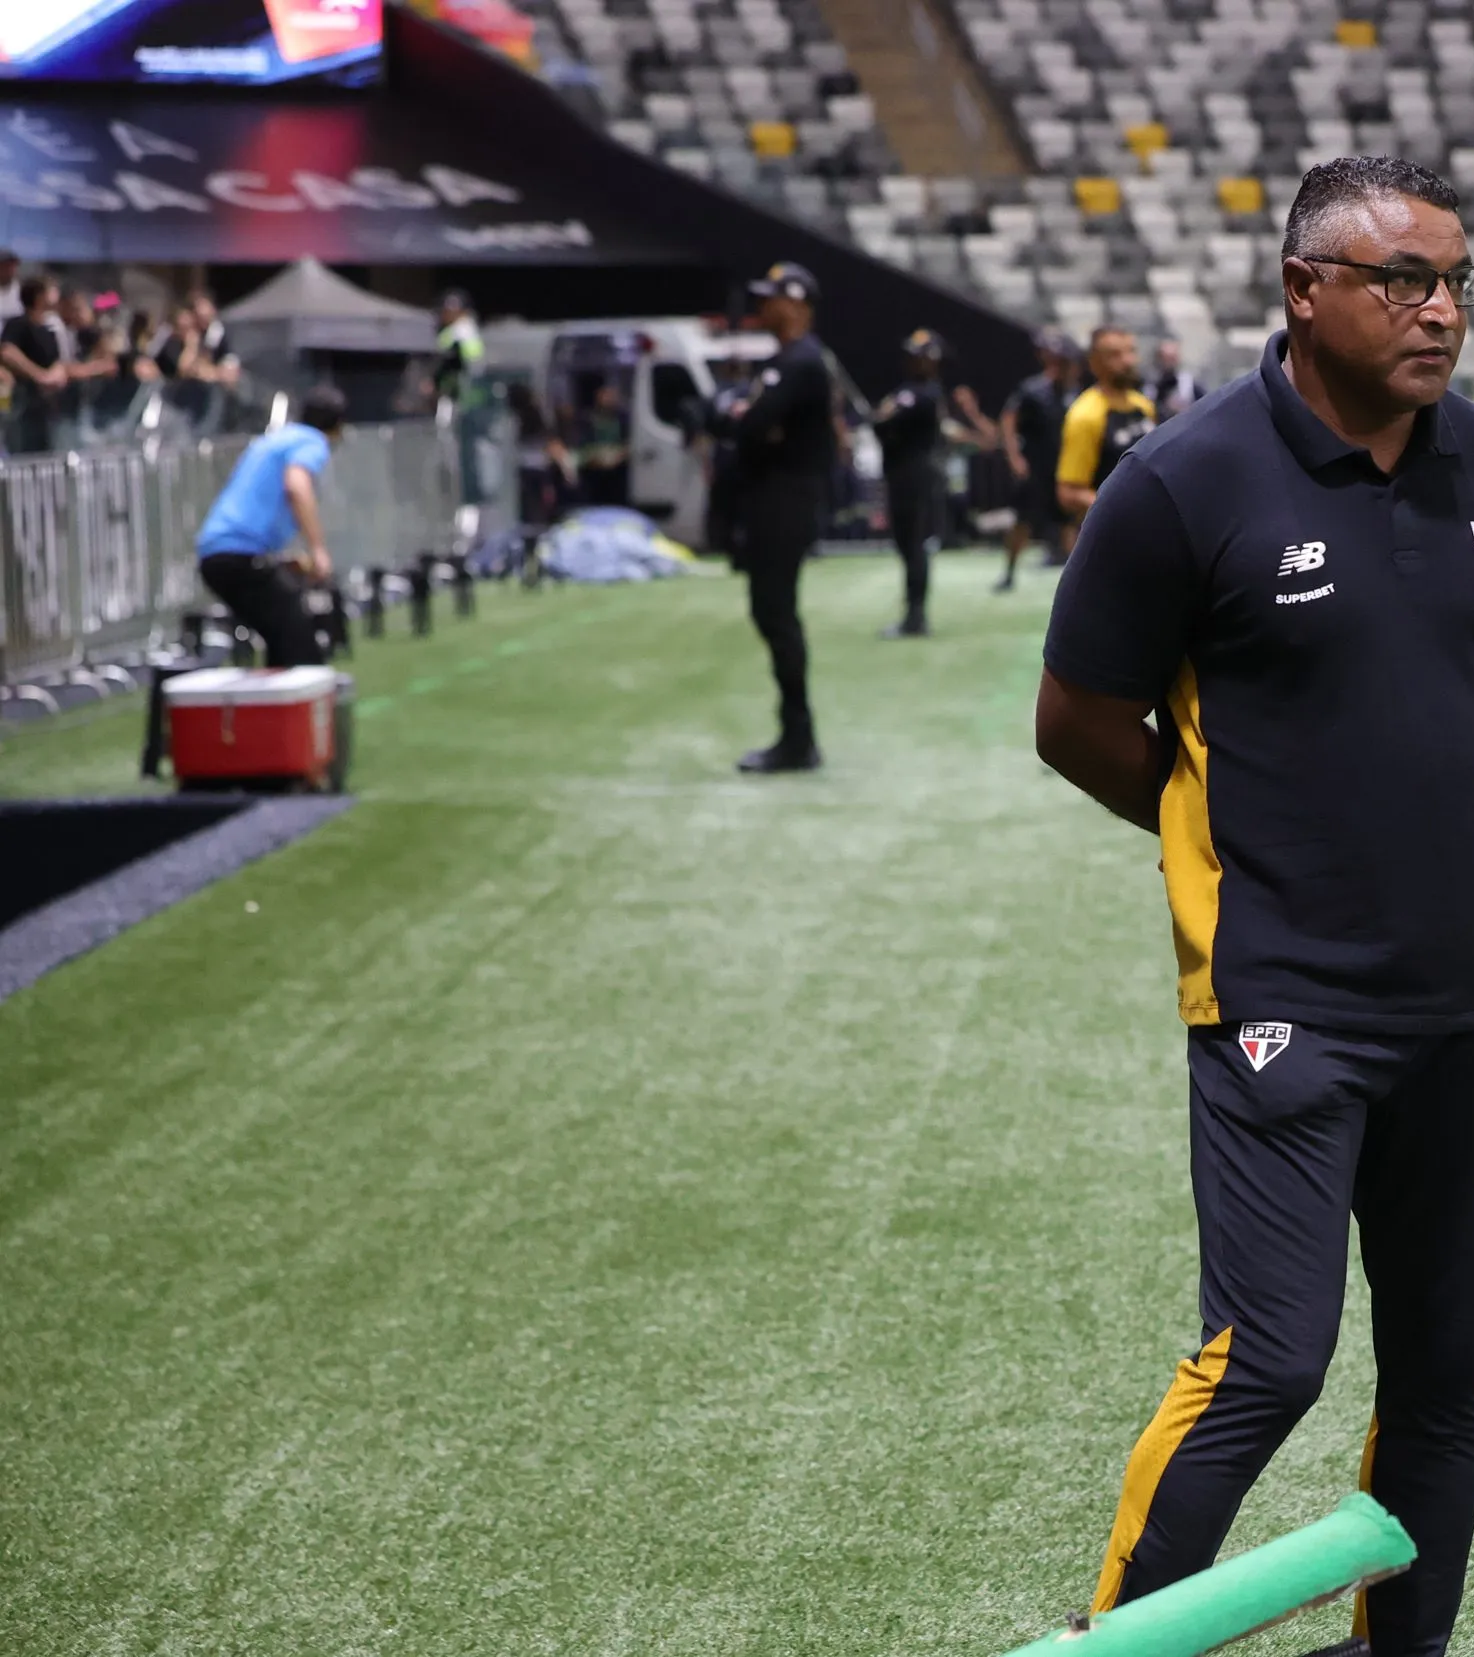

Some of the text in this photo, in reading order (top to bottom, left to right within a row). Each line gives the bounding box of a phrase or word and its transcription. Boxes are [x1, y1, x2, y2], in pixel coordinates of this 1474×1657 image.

[204, 163, 518, 212] CASA
[1275, 582, 1335, 604] SUPERBET
[1244, 1026, 1286, 1039] SPFC
